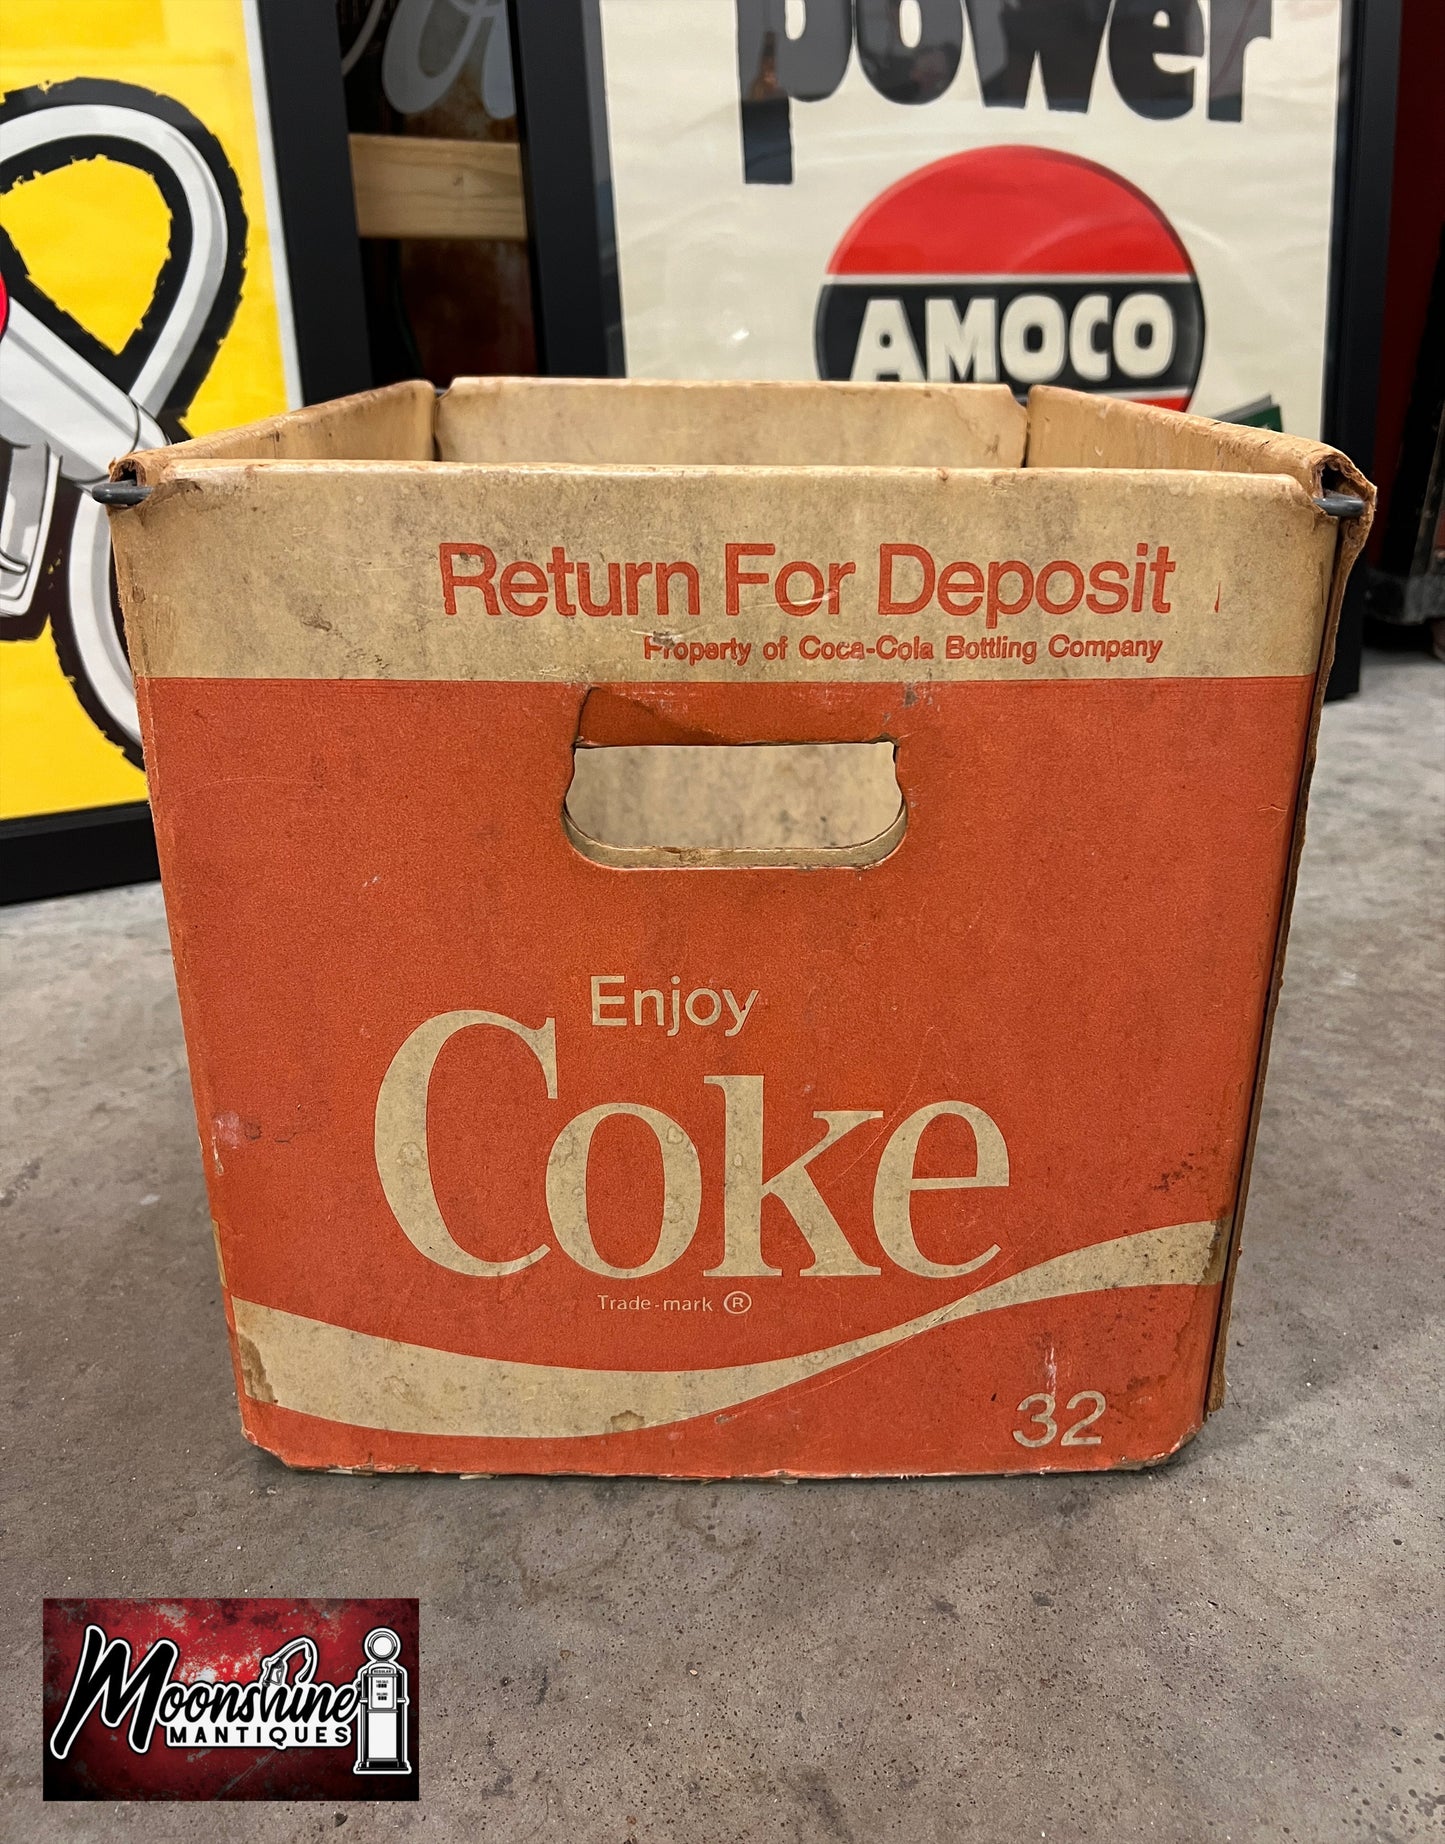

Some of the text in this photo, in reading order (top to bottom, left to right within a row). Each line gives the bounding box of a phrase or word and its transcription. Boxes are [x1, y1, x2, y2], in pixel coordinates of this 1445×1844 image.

[737, 0, 1272, 184] power
[850, 293, 1175, 384] AMOCO
[440, 542, 1176, 629] Return For Deposit
[644, 634, 1163, 666] Property of Coca-Cola Bottling Company
[589, 975, 759, 1037] Enjoy
[373, 1009, 1011, 1279] Coke
[1012, 1390, 1106, 1448] 32
